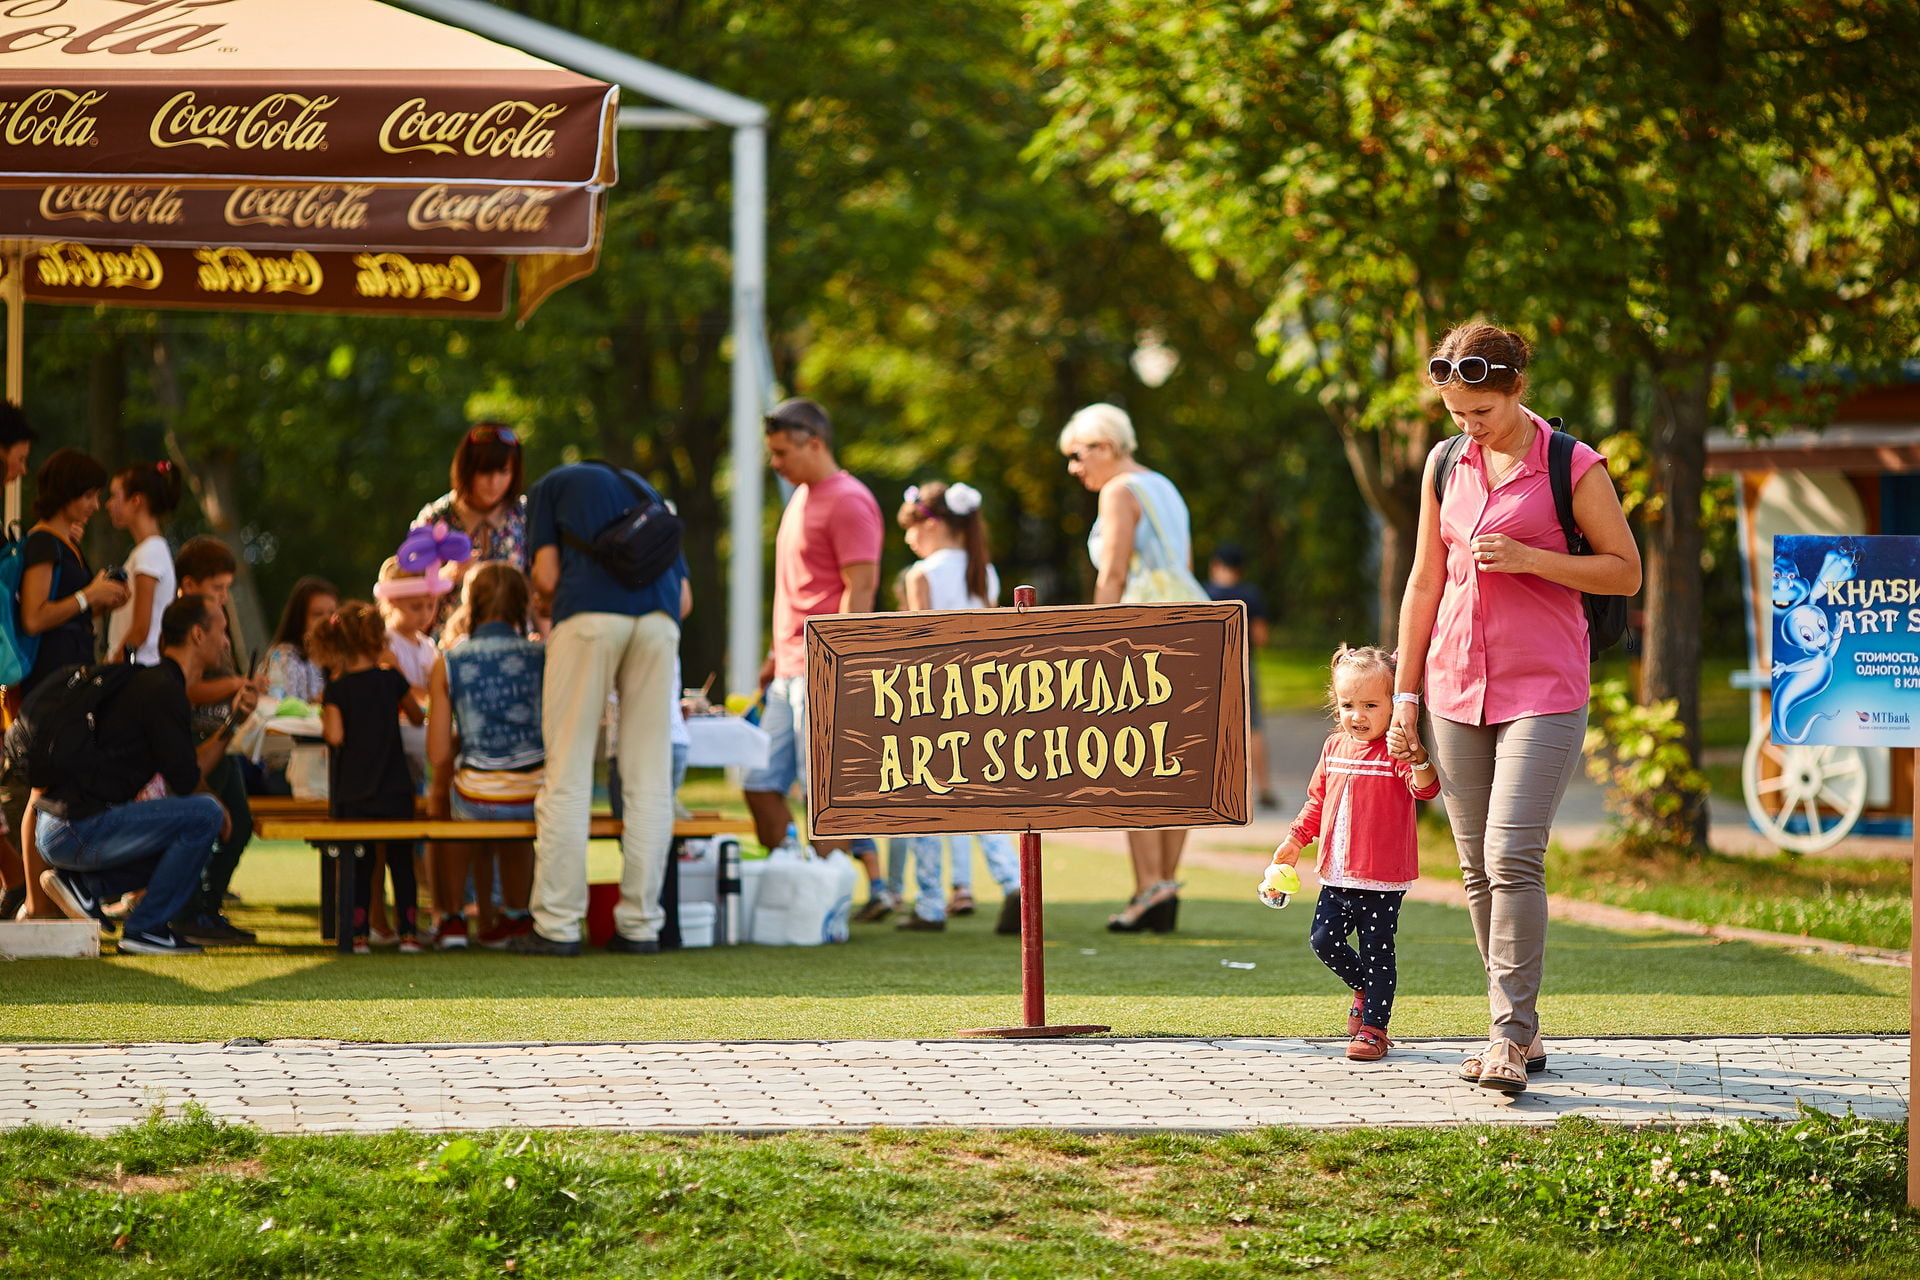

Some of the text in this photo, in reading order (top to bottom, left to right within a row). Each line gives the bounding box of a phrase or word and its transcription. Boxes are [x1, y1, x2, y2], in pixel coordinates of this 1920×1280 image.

[150, 91, 340, 151] Coca-Cola
[378, 97, 568, 159] Coca-Cola
[1833, 609, 1900, 639] ART
[1854, 651, 1919, 663] СТОИМОСТЬ
[1856, 664, 1920, 676] ОДНОГО МА
[1903, 678, 1920, 689] КЛ
[878, 721, 1182, 795] ART SCHOOL
